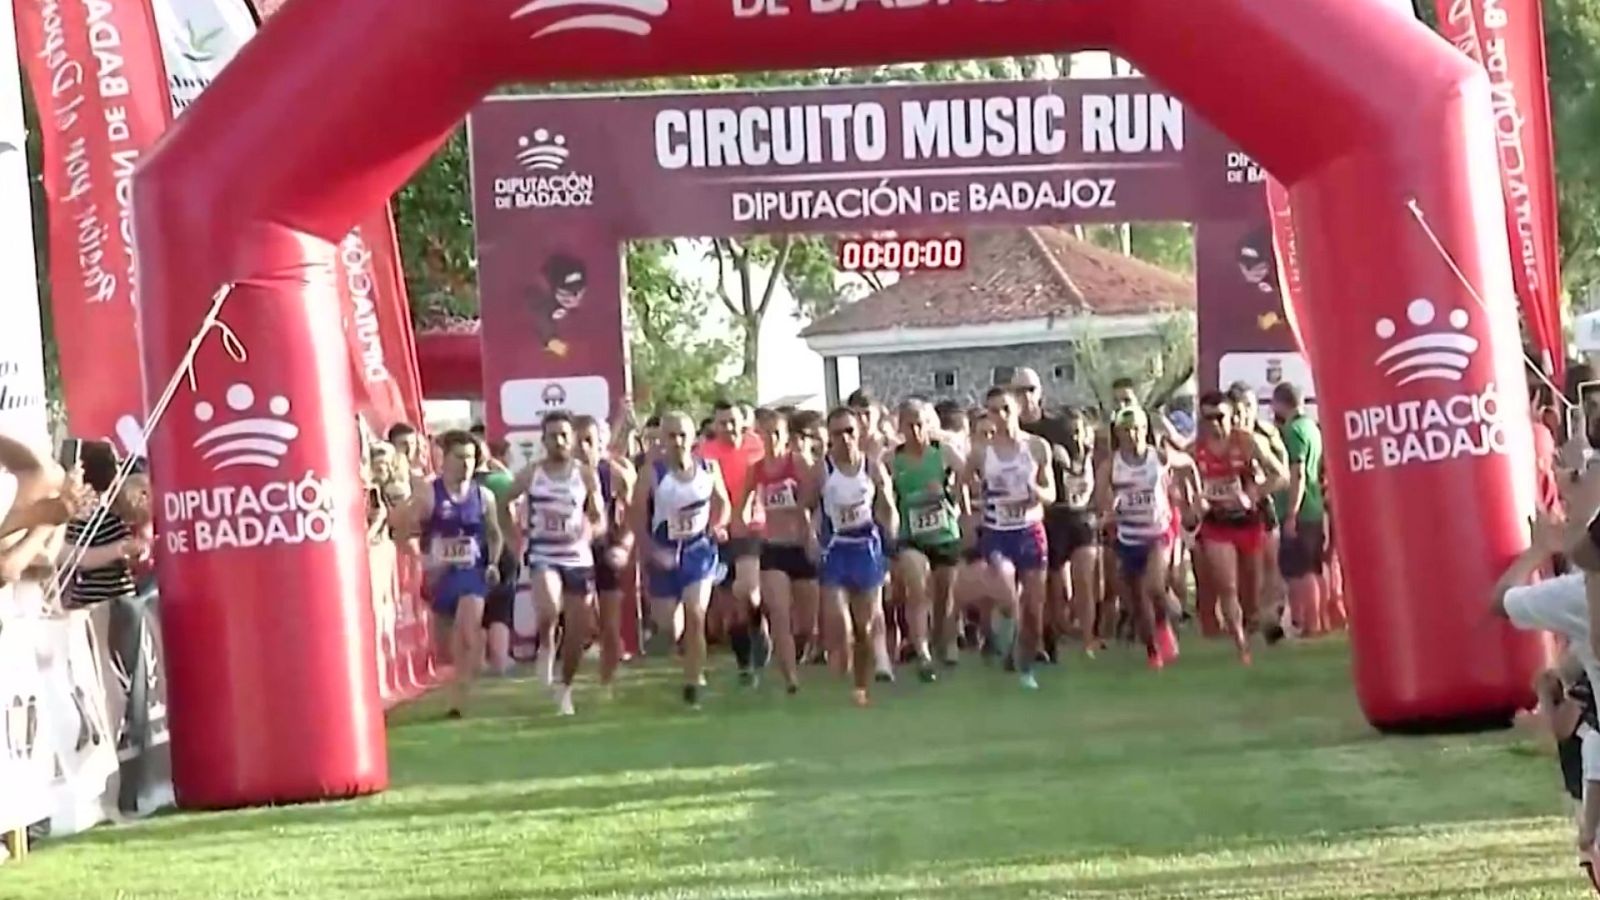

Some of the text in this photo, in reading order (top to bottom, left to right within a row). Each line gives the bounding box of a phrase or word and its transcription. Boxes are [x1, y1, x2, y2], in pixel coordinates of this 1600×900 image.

[655, 94, 1184, 168] CIRCUITO MUSIC RUN
[495, 170, 593, 194] DIPUTACIÓN
[495, 190, 593, 209] DE BADAJOZ
[732, 178, 1116, 221] DIPUTACIÓN DE BADAJOZ
[843, 239, 962, 269] 00:00:00
[1344, 383, 1499, 441] DIPUTACIÓ
[1350, 422, 1508, 472] DE BADAJO
[167, 509, 334, 554] DE BADAJO
